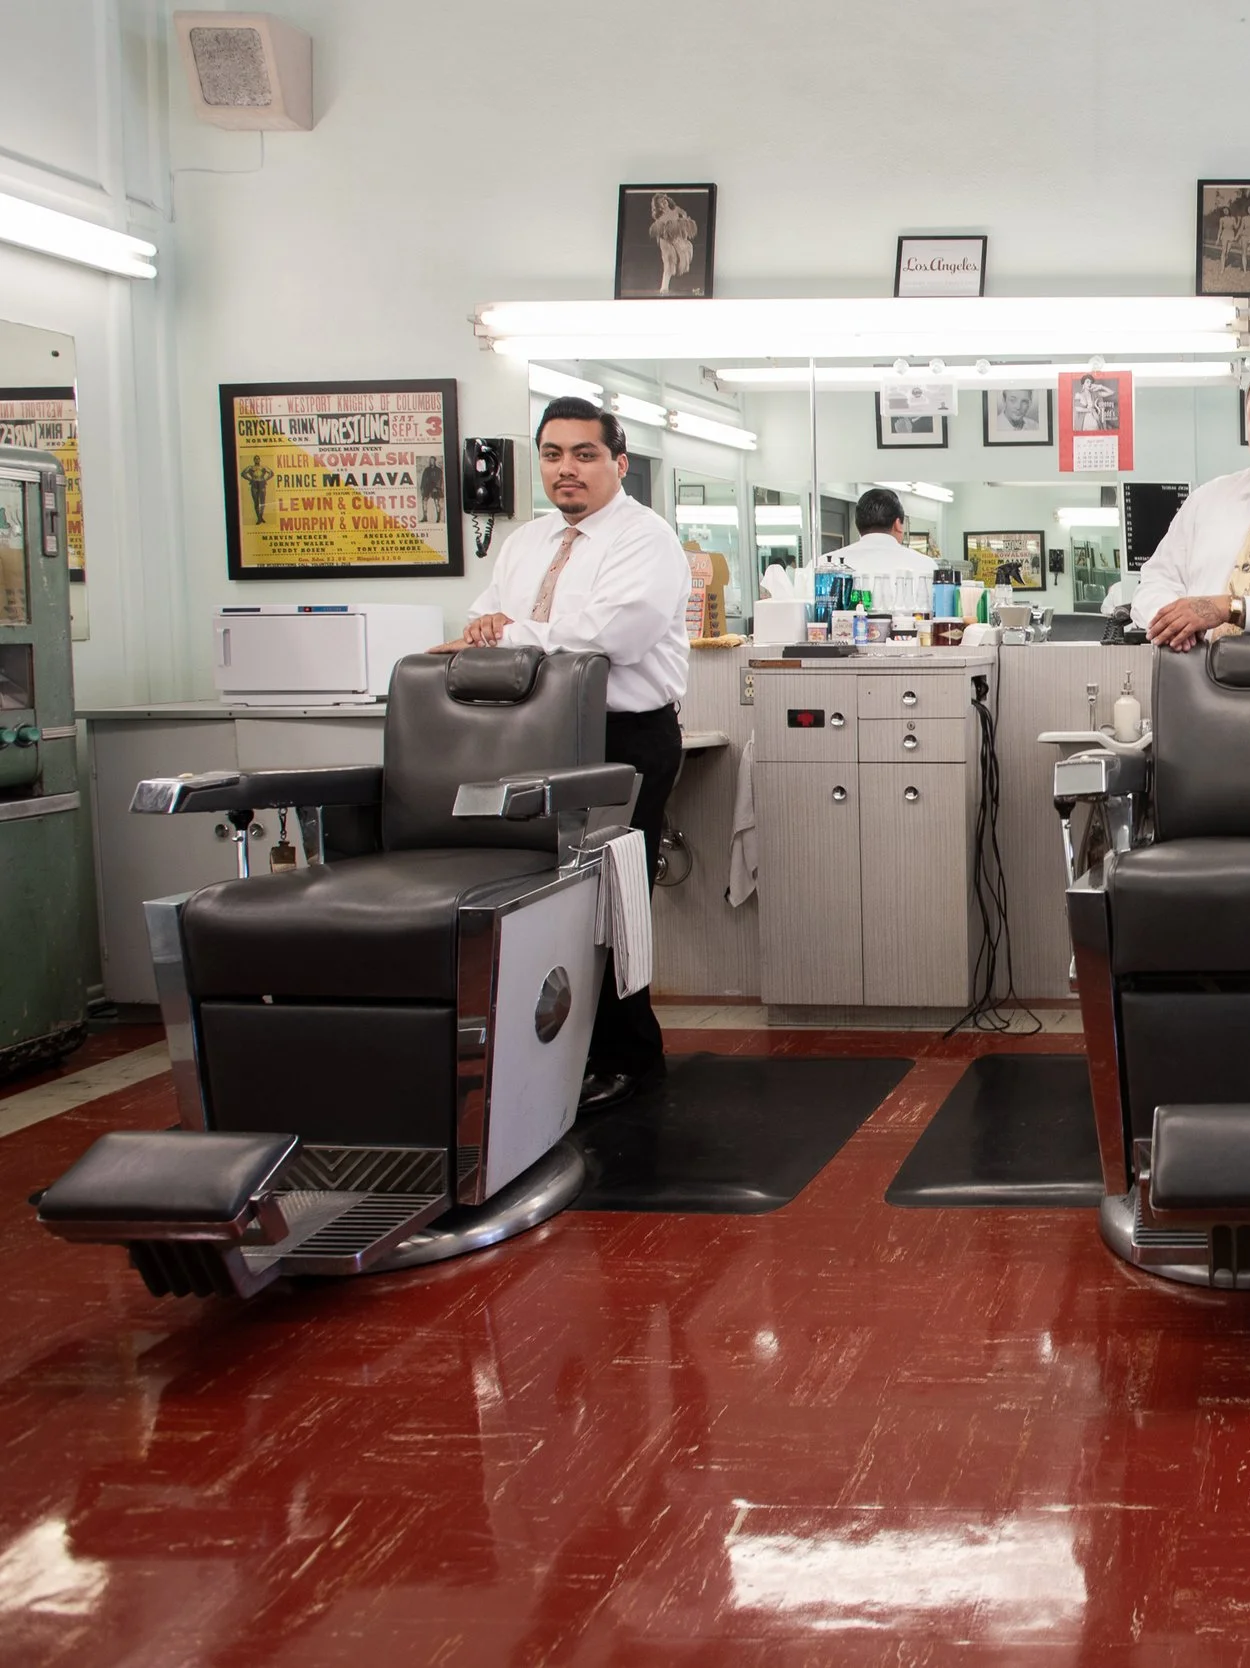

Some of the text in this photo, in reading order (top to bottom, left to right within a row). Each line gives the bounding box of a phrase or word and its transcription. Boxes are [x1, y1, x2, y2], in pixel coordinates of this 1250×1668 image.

[903, 256, 979, 275] Los Angeles
[239, 393, 442, 415] BENEFIT WESTPORT KNIGHTS OF COLUMBUS
[238, 417, 316, 436] CRYSTAL RINK
[319, 413, 389, 445] WRESTLING
[392, 415, 443, 437] SEPT. 3
[276, 451, 415, 468] KILLER KOWALSKI
[276, 471, 414, 488] PRINCE MAIAVA
[278, 495, 417, 512] LEWIN & CURTIS
[279, 515, 417, 531] MURPHY & VON HESS
